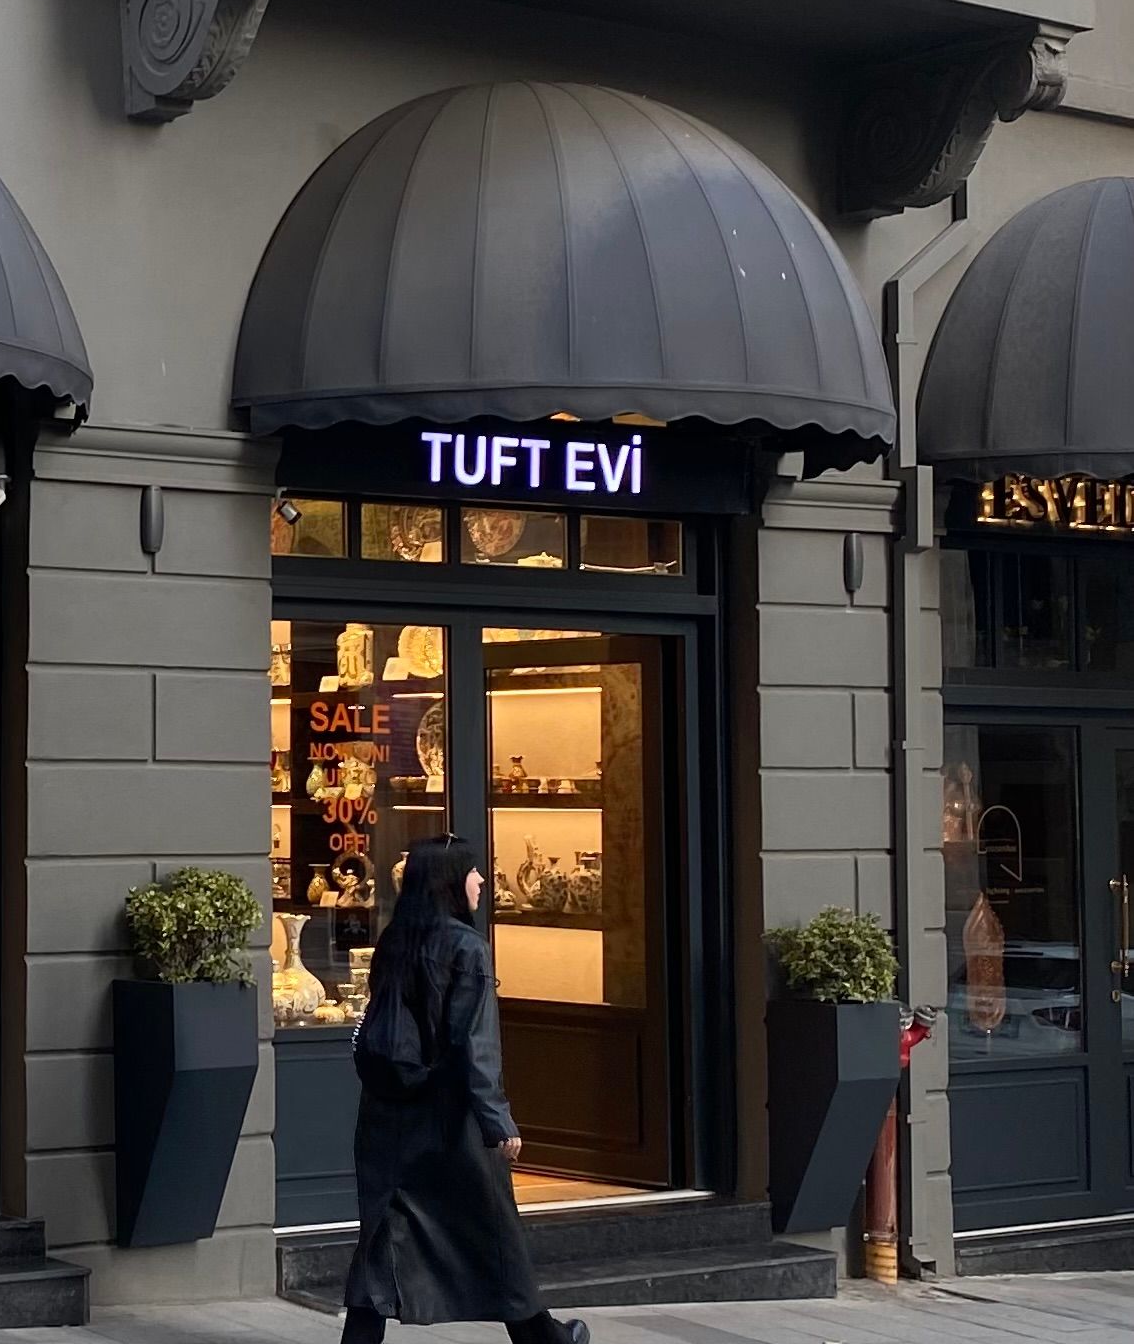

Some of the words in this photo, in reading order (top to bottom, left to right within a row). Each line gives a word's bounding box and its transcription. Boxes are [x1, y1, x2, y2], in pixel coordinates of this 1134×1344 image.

[420, 431, 552, 489] TUFT
[309, 701, 391, 735] SALE
[322, 796, 378, 825] 30%
[329, 833, 370, 852] OFF!
